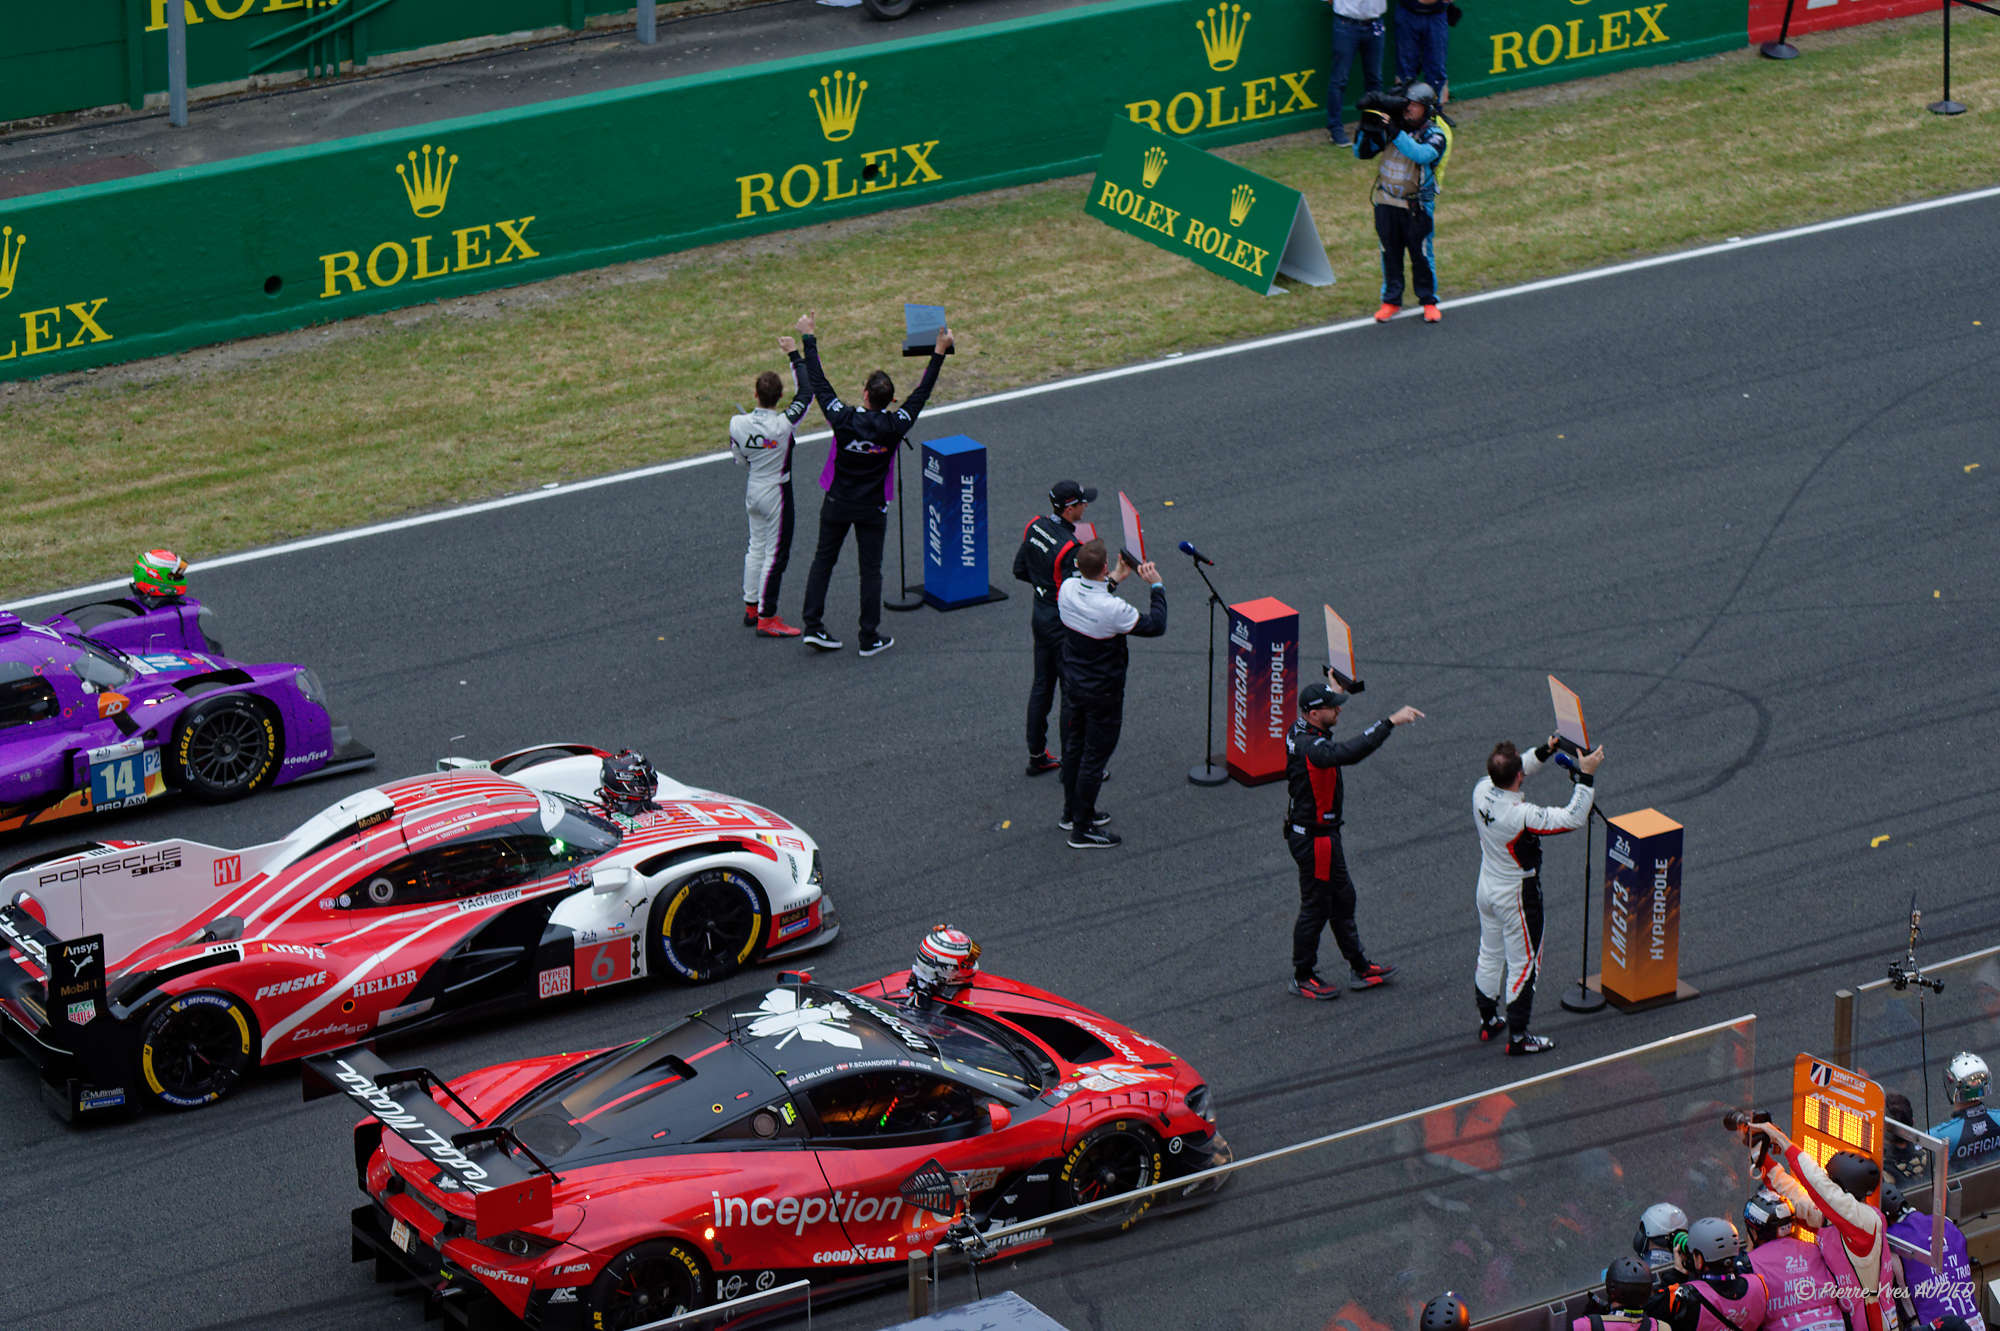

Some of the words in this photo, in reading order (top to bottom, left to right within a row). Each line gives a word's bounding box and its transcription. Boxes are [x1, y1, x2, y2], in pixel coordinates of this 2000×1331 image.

[1488, 3, 1671, 76] ROLEX
[1125, 69, 1318, 137] ROLEX
[736, 140, 943, 220] ROLEX
[1098, 180, 1181, 237] ROLEX
[1183, 219, 1269, 278] ROLEX
[319, 215, 541, 299] ROLEX
[961, 474, 976, 567] HYPERPOLE
[928, 505, 942, 567] LMP2
[1233, 655, 1248, 754] HYPERCAR
[1267, 642, 1285, 739] HYPERPOLE
[180, 726, 194, 765] EAGLE
[249, 718, 275, 789] GOODYEAR
[284, 749, 328, 766] GOODYEAR
[145, 751, 160, 773] P2
[100, 759, 136, 800] 14
[96, 803, 121, 813] PRO
[358, 814, 380, 828] Mobil
[39, 847, 182, 888] PORSCHE
[131, 859, 182, 878] 963
[216, 858, 239, 885] HY
[1650, 858, 1668, 960] HYPERPOLE
[1610, 880, 1629, 969] LMGT3
[63, 942, 99, 958] Ansys
[262, 943, 326, 960] Ansys
[591, 944, 615, 982] 6
[60, 981, 90, 997] Mobil
[255, 970, 327, 1000] PENSKE
[353, 969, 418, 998] HELLER
[541, 968, 568, 980] HYPER
[541, 980, 569, 995] CAR
[188, 994, 230, 1009] MICHELIN
[1833, 1071, 1866, 1088] UNITED
[1061, 1139, 1086, 1182] EAGLE
[712, 1191, 903, 1236] inception
[986, 1227, 1046, 1250] PTIMUM
[564, 1263, 591, 1273] IMSA
[670, 1247, 699, 1277] EAGLE
[813, 1246, 896, 1264] GOODYEAR
[1948, 1254, 1958, 1267] TV
[471, 1264, 529, 1286] GOODYEAR
